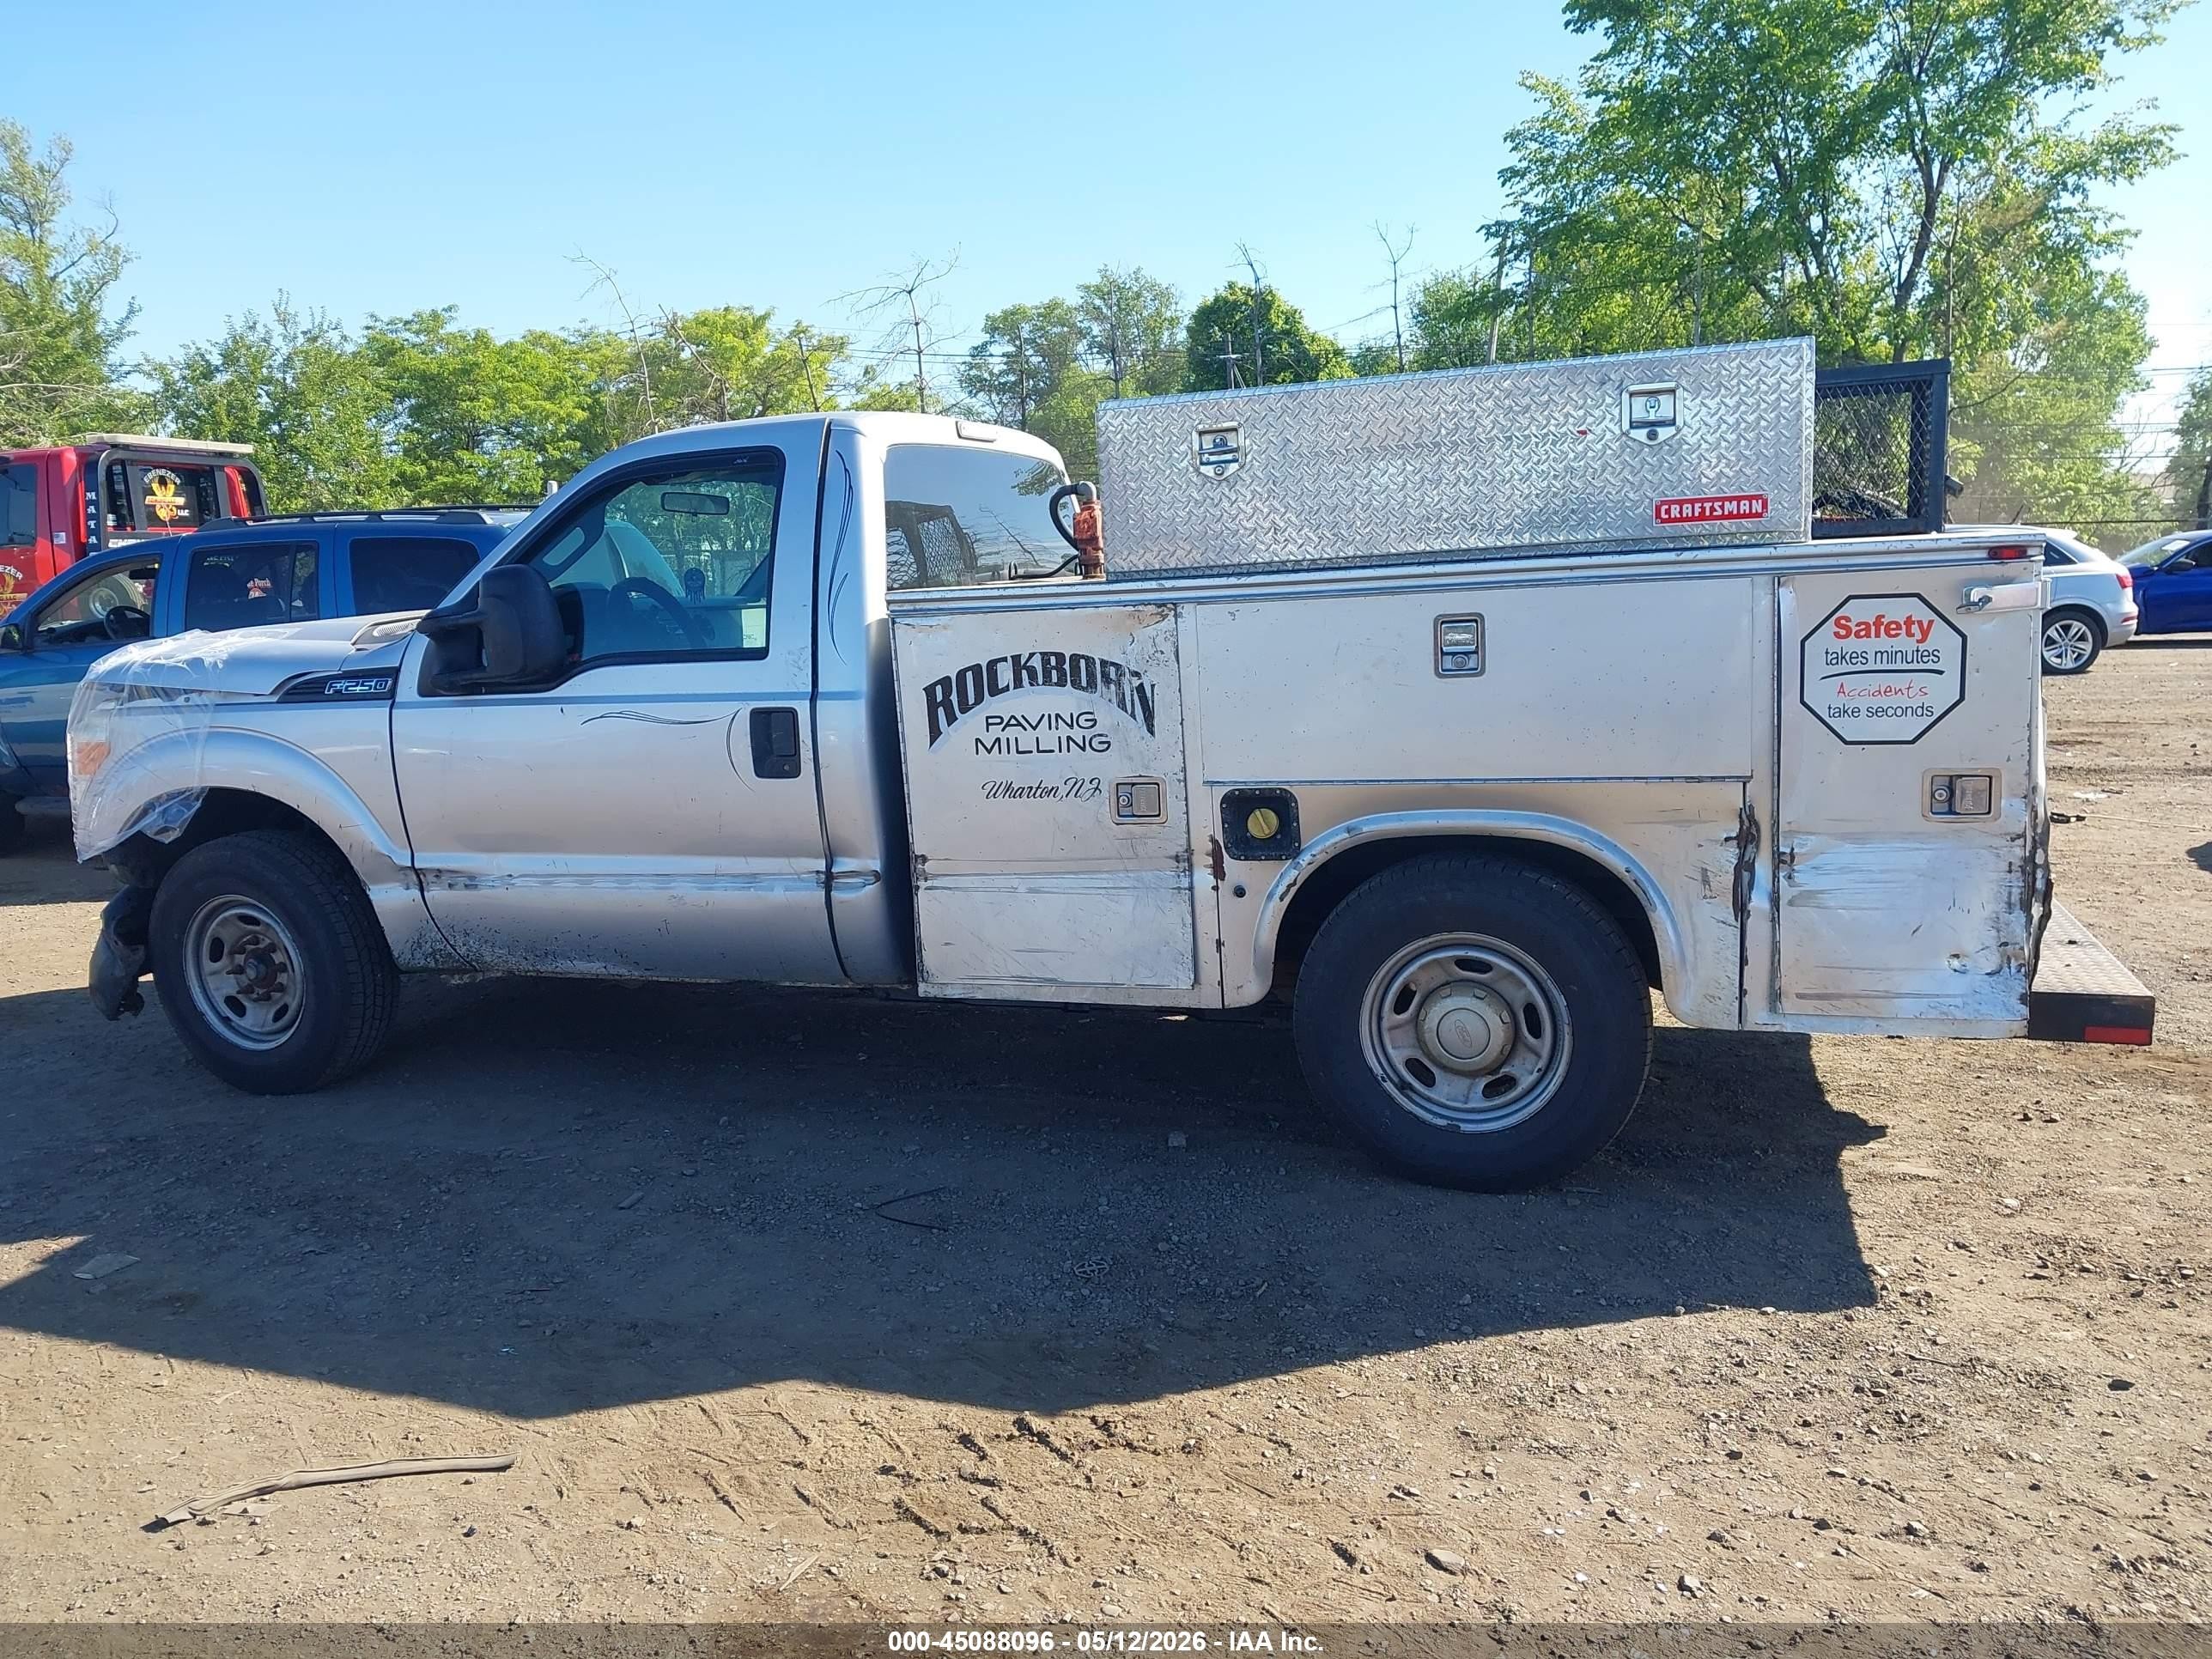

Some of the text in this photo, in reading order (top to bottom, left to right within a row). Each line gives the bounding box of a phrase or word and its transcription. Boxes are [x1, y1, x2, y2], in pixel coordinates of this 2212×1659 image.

[143, 468, 181, 485] EBENEZER
[1661, 499, 1763, 519] CRAFTSMAN
[1833, 613, 1935, 644] Safety
[1825, 645, 1941, 666] takes minutes
[1837, 679, 1929, 700] Accidents
[922, 651, 1156, 750] ROCKBORN
[1827, 702, 1934, 719] take seconds
[985, 711, 1098, 733] PAVING
[975, 733, 1112, 756] MILLING
